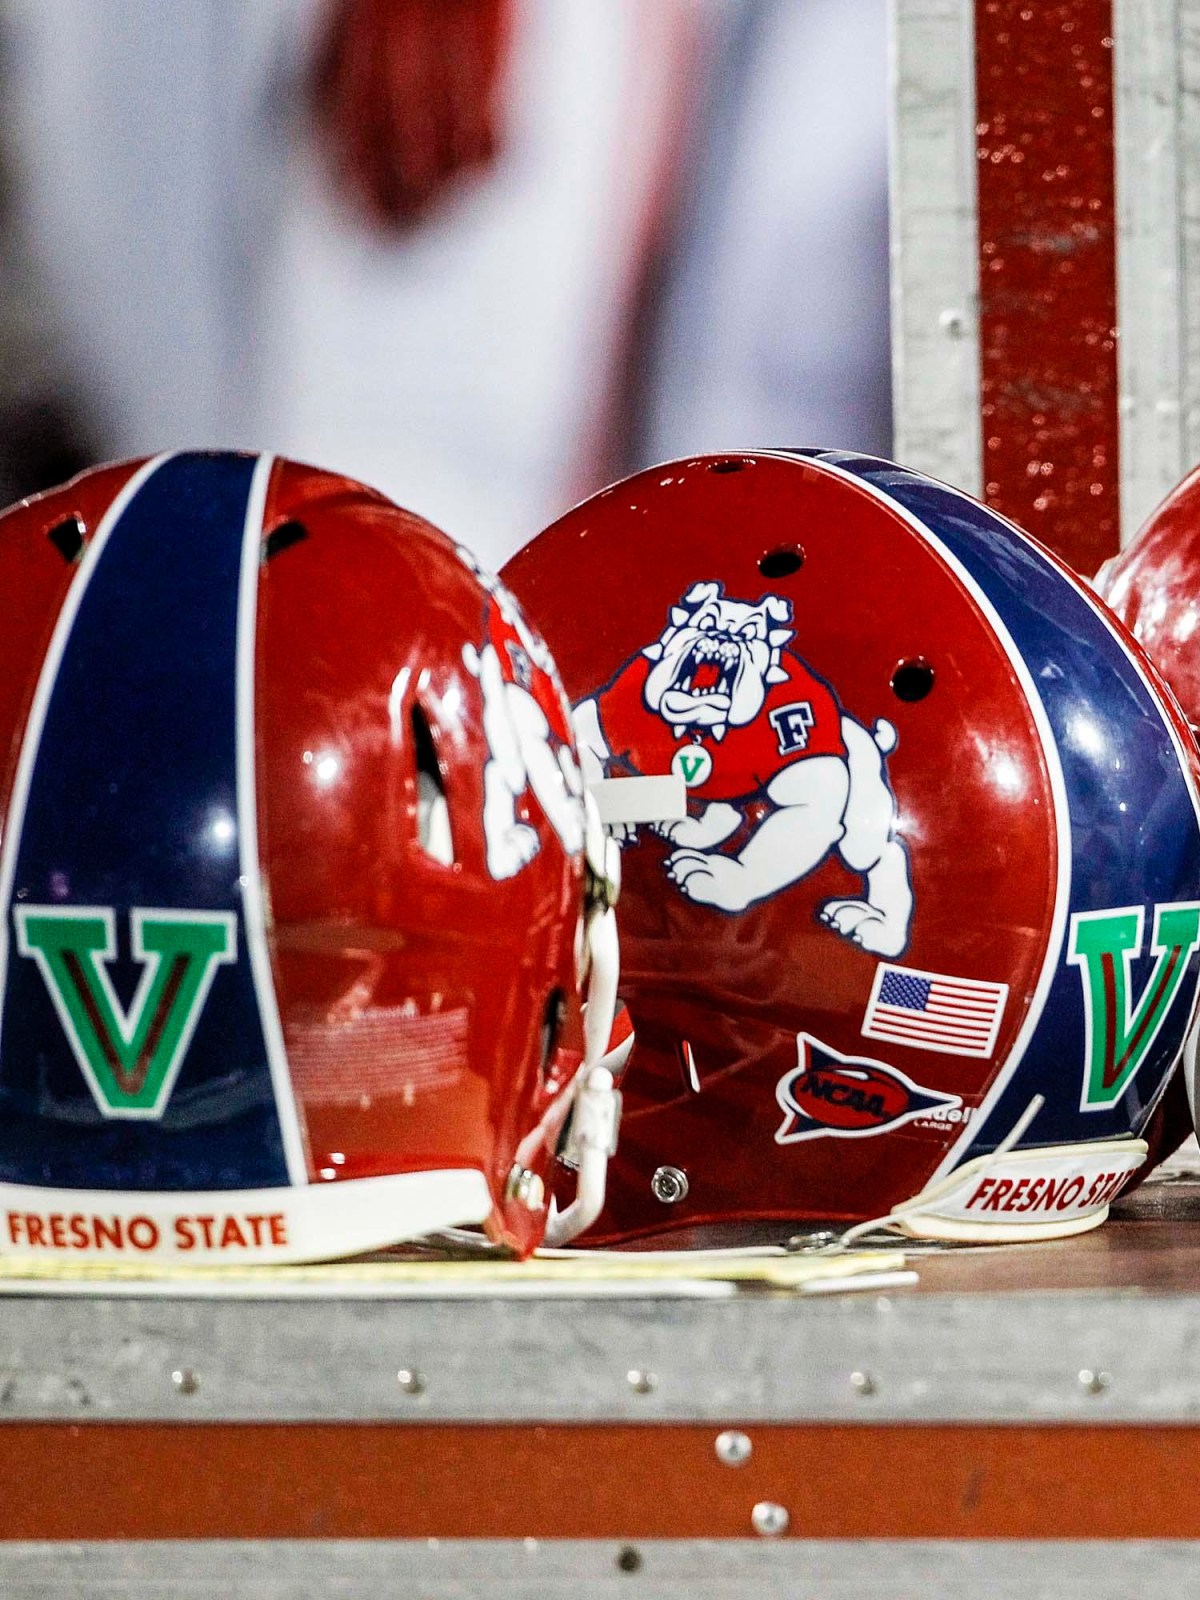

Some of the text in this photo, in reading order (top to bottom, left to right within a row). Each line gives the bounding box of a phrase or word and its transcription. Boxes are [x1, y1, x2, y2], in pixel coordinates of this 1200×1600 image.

[768, 702, 814, 755] F
[679, 755, 704, 782] V
[11, 904, 237, 1120] V
[801, 1073, 887, 1118] NCAA
[965, 1167, 1137, 1212] FRESNO STAT
[7, 1209, 288, 1250] FRESNO STATE
